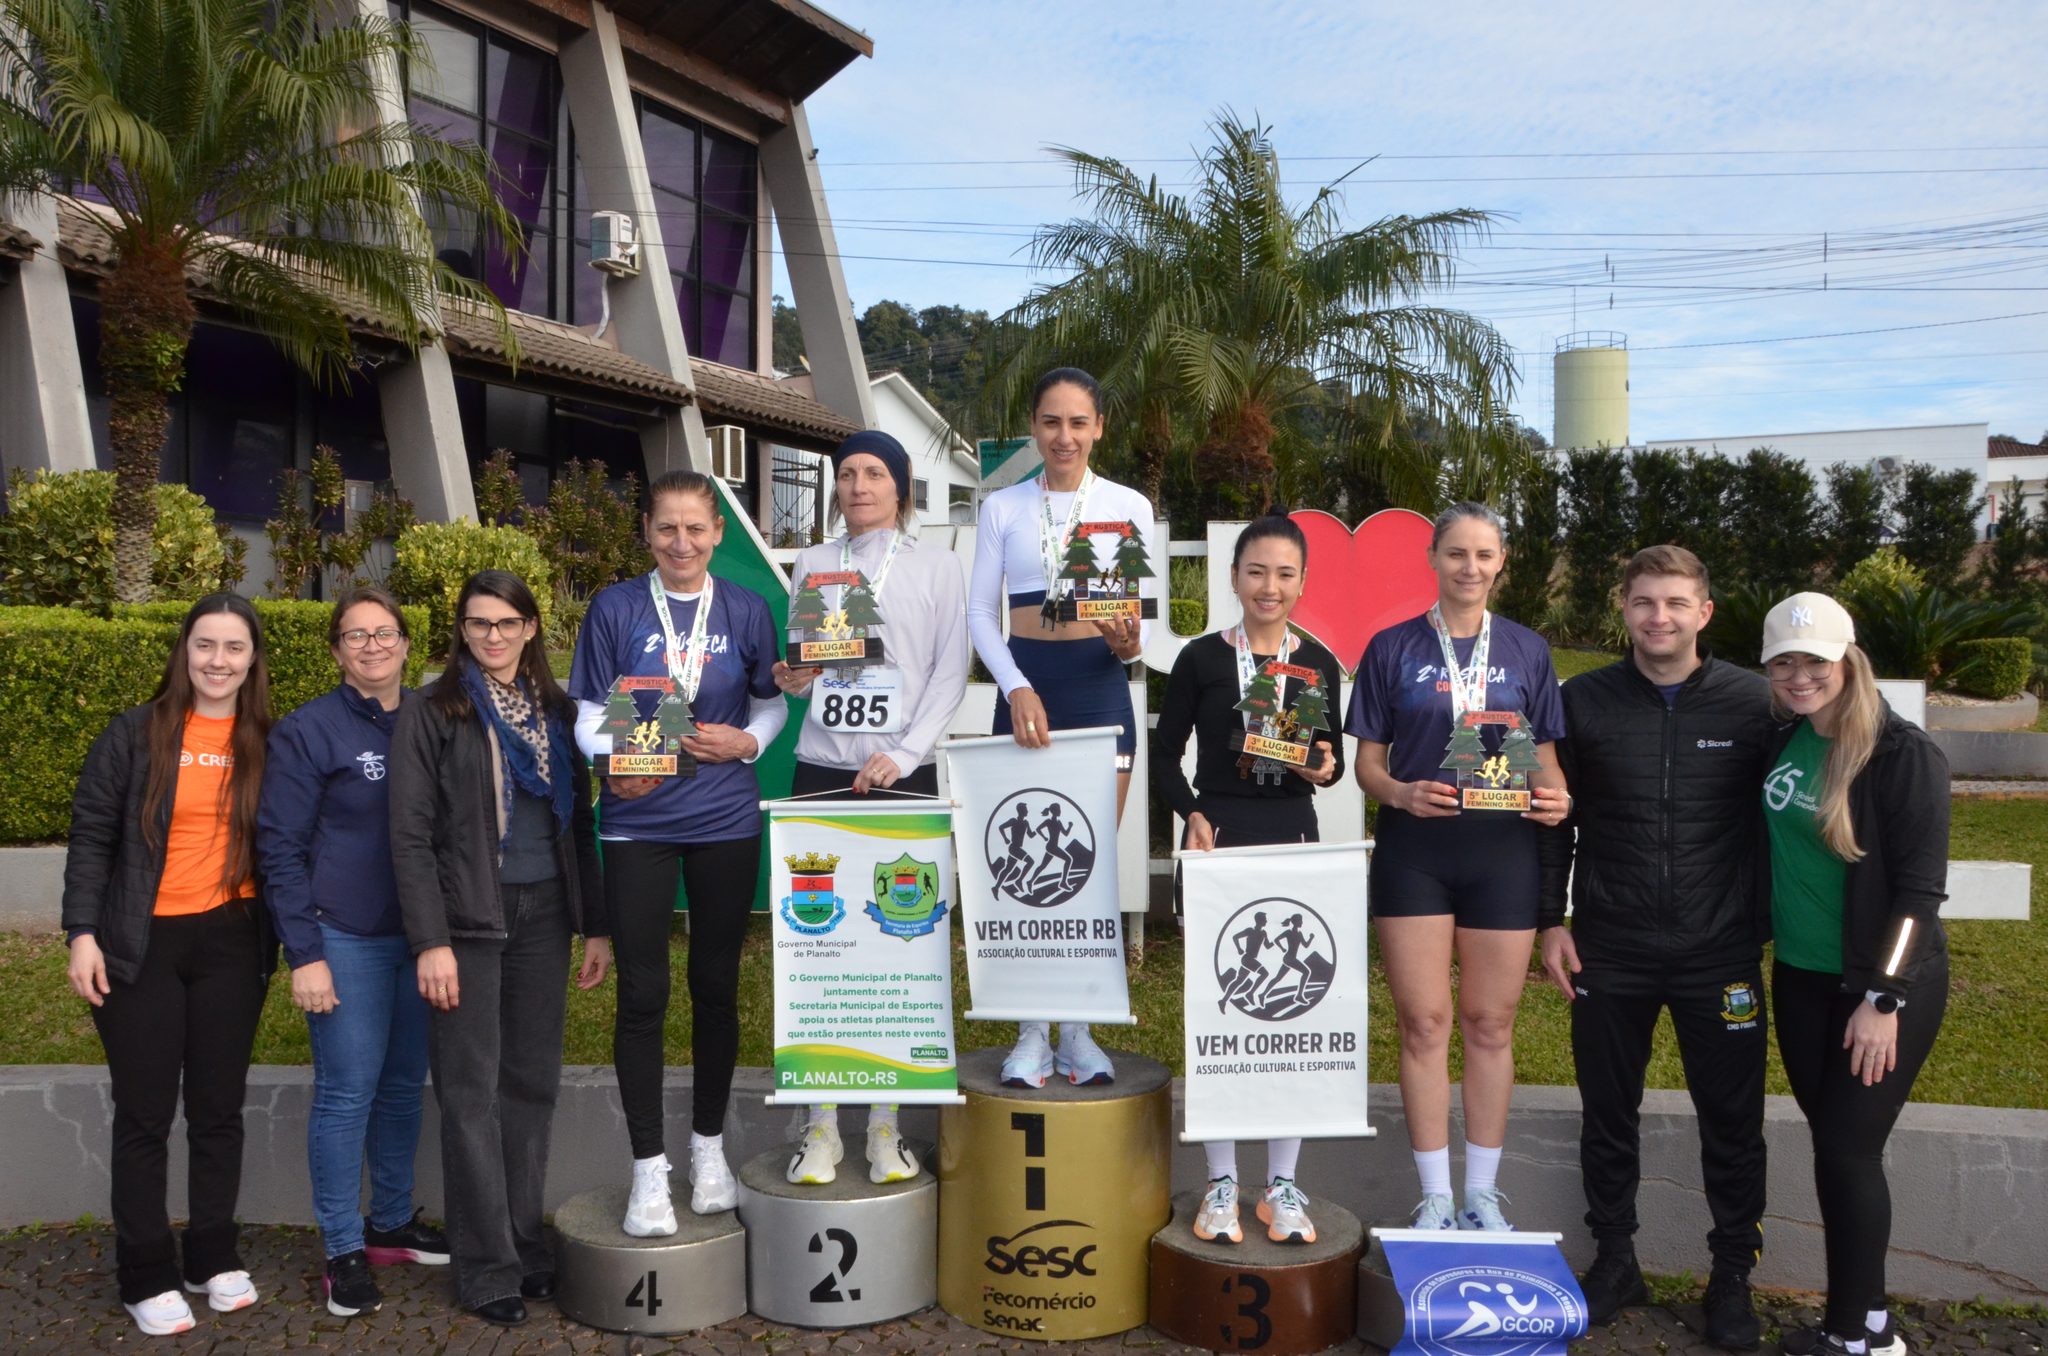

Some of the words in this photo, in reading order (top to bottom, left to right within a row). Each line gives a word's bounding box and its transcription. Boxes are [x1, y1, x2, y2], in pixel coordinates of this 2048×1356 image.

[1095, 603, 1128, 611] LUGAR
[818, 643, 852, 651] LUGAR
[822, 678, 852, 689] Sesc
[822, 694, 889, 727] 885
[1262, 740, 1296, 754] LUGAR
[1707, 739, 1733, 748] Sicredi
[1246, 745, 1282, 758] FEMININO
[1282, 753, 1298, 761] 5KM
[628, 758, 663, 766] LUGAR
[1482, 792, 1517, 801] LUGAR
[794, 926, 831, 934] PLANALTO
[974, 920, 1013, 941] VEM
[1018, 919, 1088, 940] CORRER
[1093, 918, 1116, 939] RB
[816, 940, 857, 949] Municipal
[806, 950, 841, 958] Planalto
[977, 947, 1026, 960] ASSOCIAÇÃO
[1027, 948, 1066, 958] CULTURAL
[1067, 948, 1073, 958] E
[1074, 947, 1117, 958] ESPORTIVA
[789, 974, 797, 982] O
[799, 974, 839, 982] Governo
[842, 973, 887, 984] Municipal
[889, 973, 902, 982] de
[904, 973, 943, 982] Planalto
[823, 987, 878, 997] juntamente
[880, 988, 901, 996] com
[903, 988, 909, 996] a
[789, 1002, 837, 1010] Secretaria
[840, 1001, 885, 1012] Municipal
[888, 1001, 899, 1010] de
[902, 1002, 944, 1011] Esportes
[799, 1016, 825, 1026] apoia
[840, 1015, 873, 1024] atletas
[875, 1015, 935, 1026] planaltenses
[787, 1031, 805, 1040] que
[808, 1029, 833, 1038] estão
[836, 1029, 882, 1039] presentes
[885, 1029, 911, 1038] neste
[913, 1030, 946, 1038] evento
[1196, 1035, 1238, 1056] VEM
[1244, 1033, 1323, 1055] CORRER
[1329, 1032, 1356, 1053] RB
[1196, 1062, 1251, 1075] ASSOCIAÇÃO
[1254, 1063, 1297, 1073] CULTURAL
[1300, 1062, 1305, 1071] E
[1307, 1061, 1356, 1072] ESPORTIVA
[781, 1071, 898, 1085] PLANALTO-RS
[1011, 1112, 1046, 1211] 1
[984, 1234, 1097, 1278] Sesc
[808, 1228, 862, 1303] 2
[625, 1270, 662, 1316] 4
[1220, 1273, 1273, 1350] 3
[1560, 1295, 1577, 1323] Região
[984, 1309, 1042, 1333] Senac
[1502, 1316, 1555, 1334] GCOR
